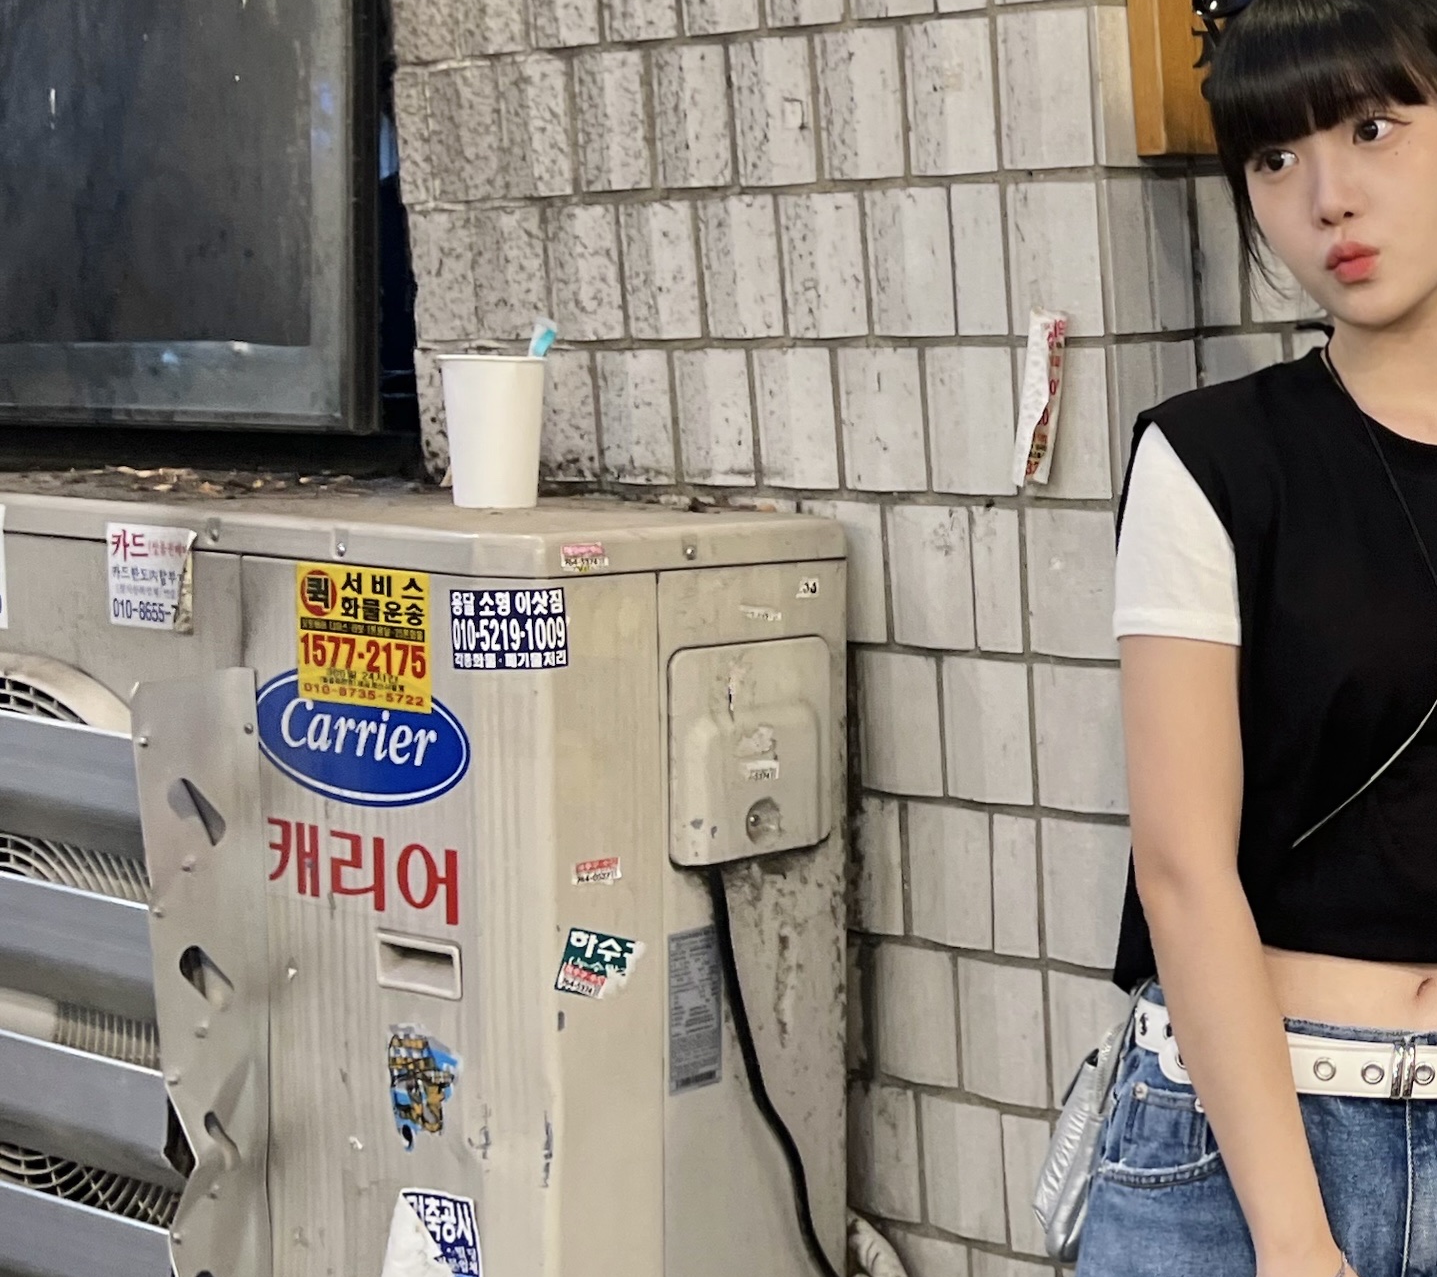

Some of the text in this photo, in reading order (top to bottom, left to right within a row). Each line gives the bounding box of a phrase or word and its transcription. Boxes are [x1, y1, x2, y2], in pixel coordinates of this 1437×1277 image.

[111, 528, 150, 562] 카드
[306, 576, 331, 610] 퀵
[478, 591, 511, 617] 소형
[515, 588, 564, 616] 이삿짐
[341, 596, 425, 626] 화물운송
[280, 697, 438, 767] Carrier
[267, 817, 460, 926] 캐리어
